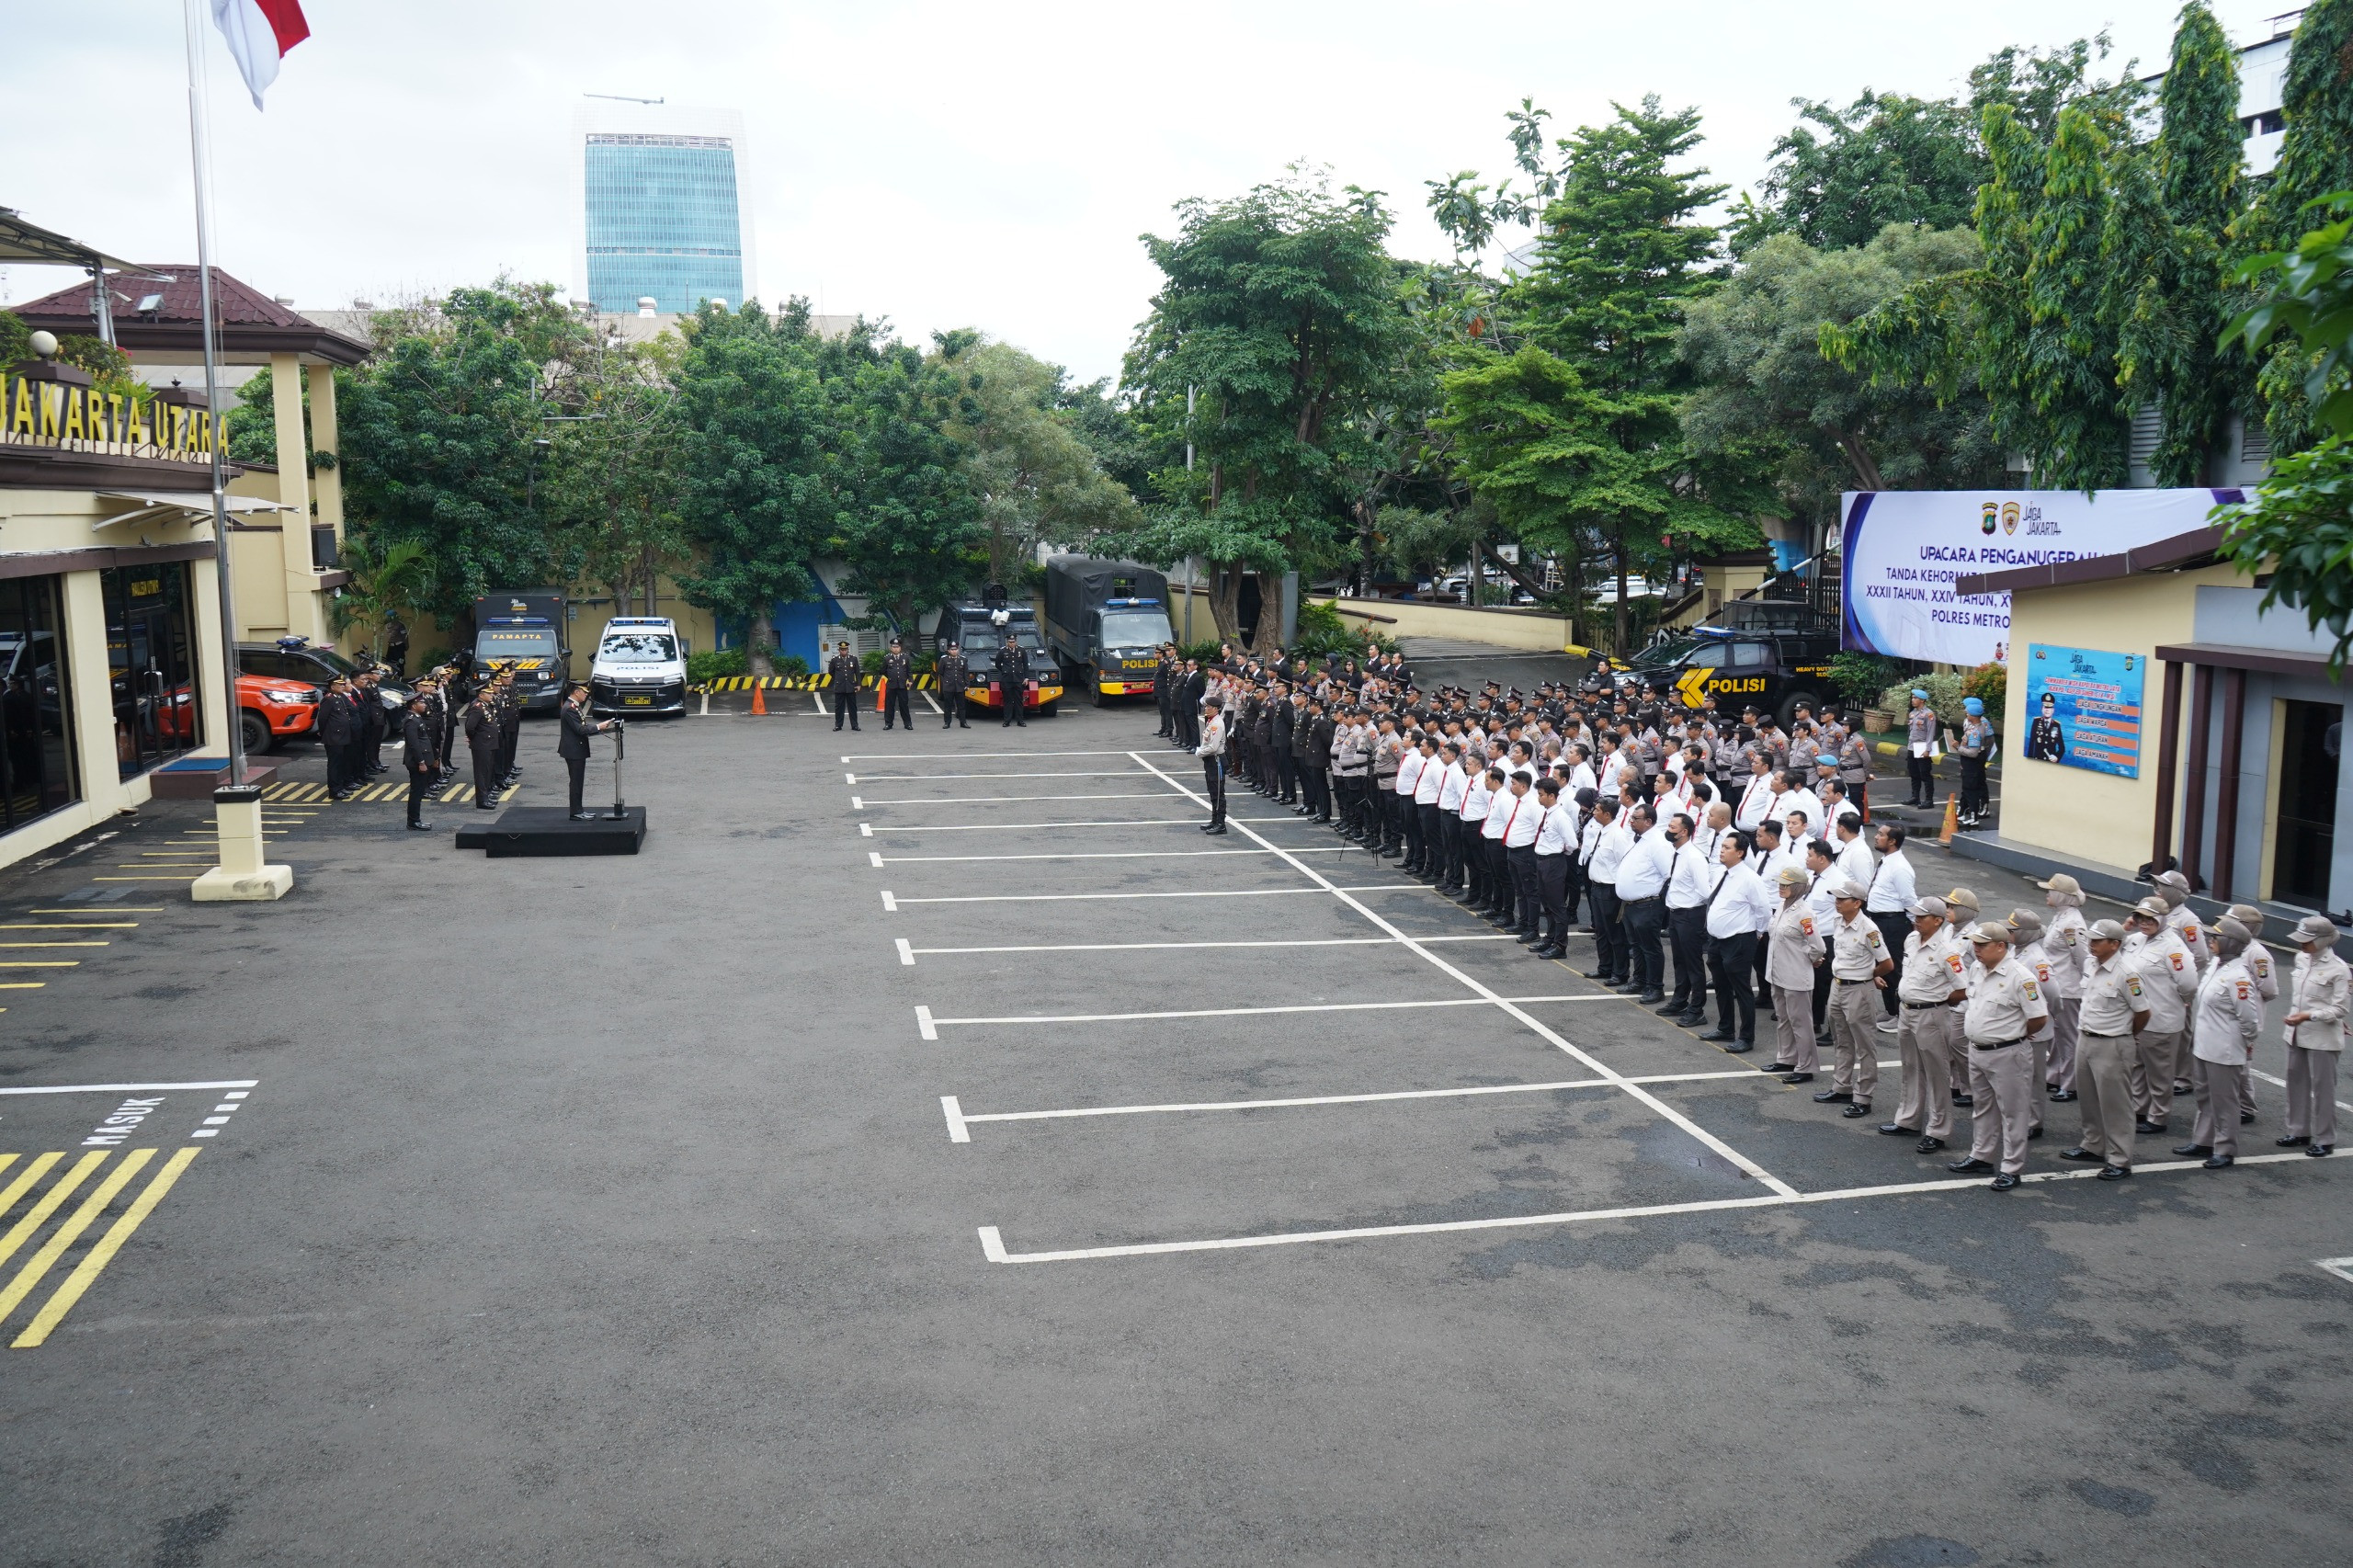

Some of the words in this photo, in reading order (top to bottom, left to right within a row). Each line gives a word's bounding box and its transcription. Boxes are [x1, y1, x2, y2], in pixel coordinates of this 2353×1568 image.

[154, 400, 229, 456] UTARA
[2022, 506, 2041, 521] JAGA
[1920, 546, 1976, 562] UPACARA
[1886, 567, 1918, 581] TANDA
[1866, 585, 1891, 597] XXXII
[1893, 586, 1928, 603] TAHUN,
[1931, 589, 1957, 603] XXIV
[1932, 609, 1970, 625] POLRES
[1972, 613, 2010, 629] METRO
[1122, 659, 1159, 668] POLISI
[1709, 678, 1766, 693] POLISI
[81, 1096, 166, 1145] MASUK
